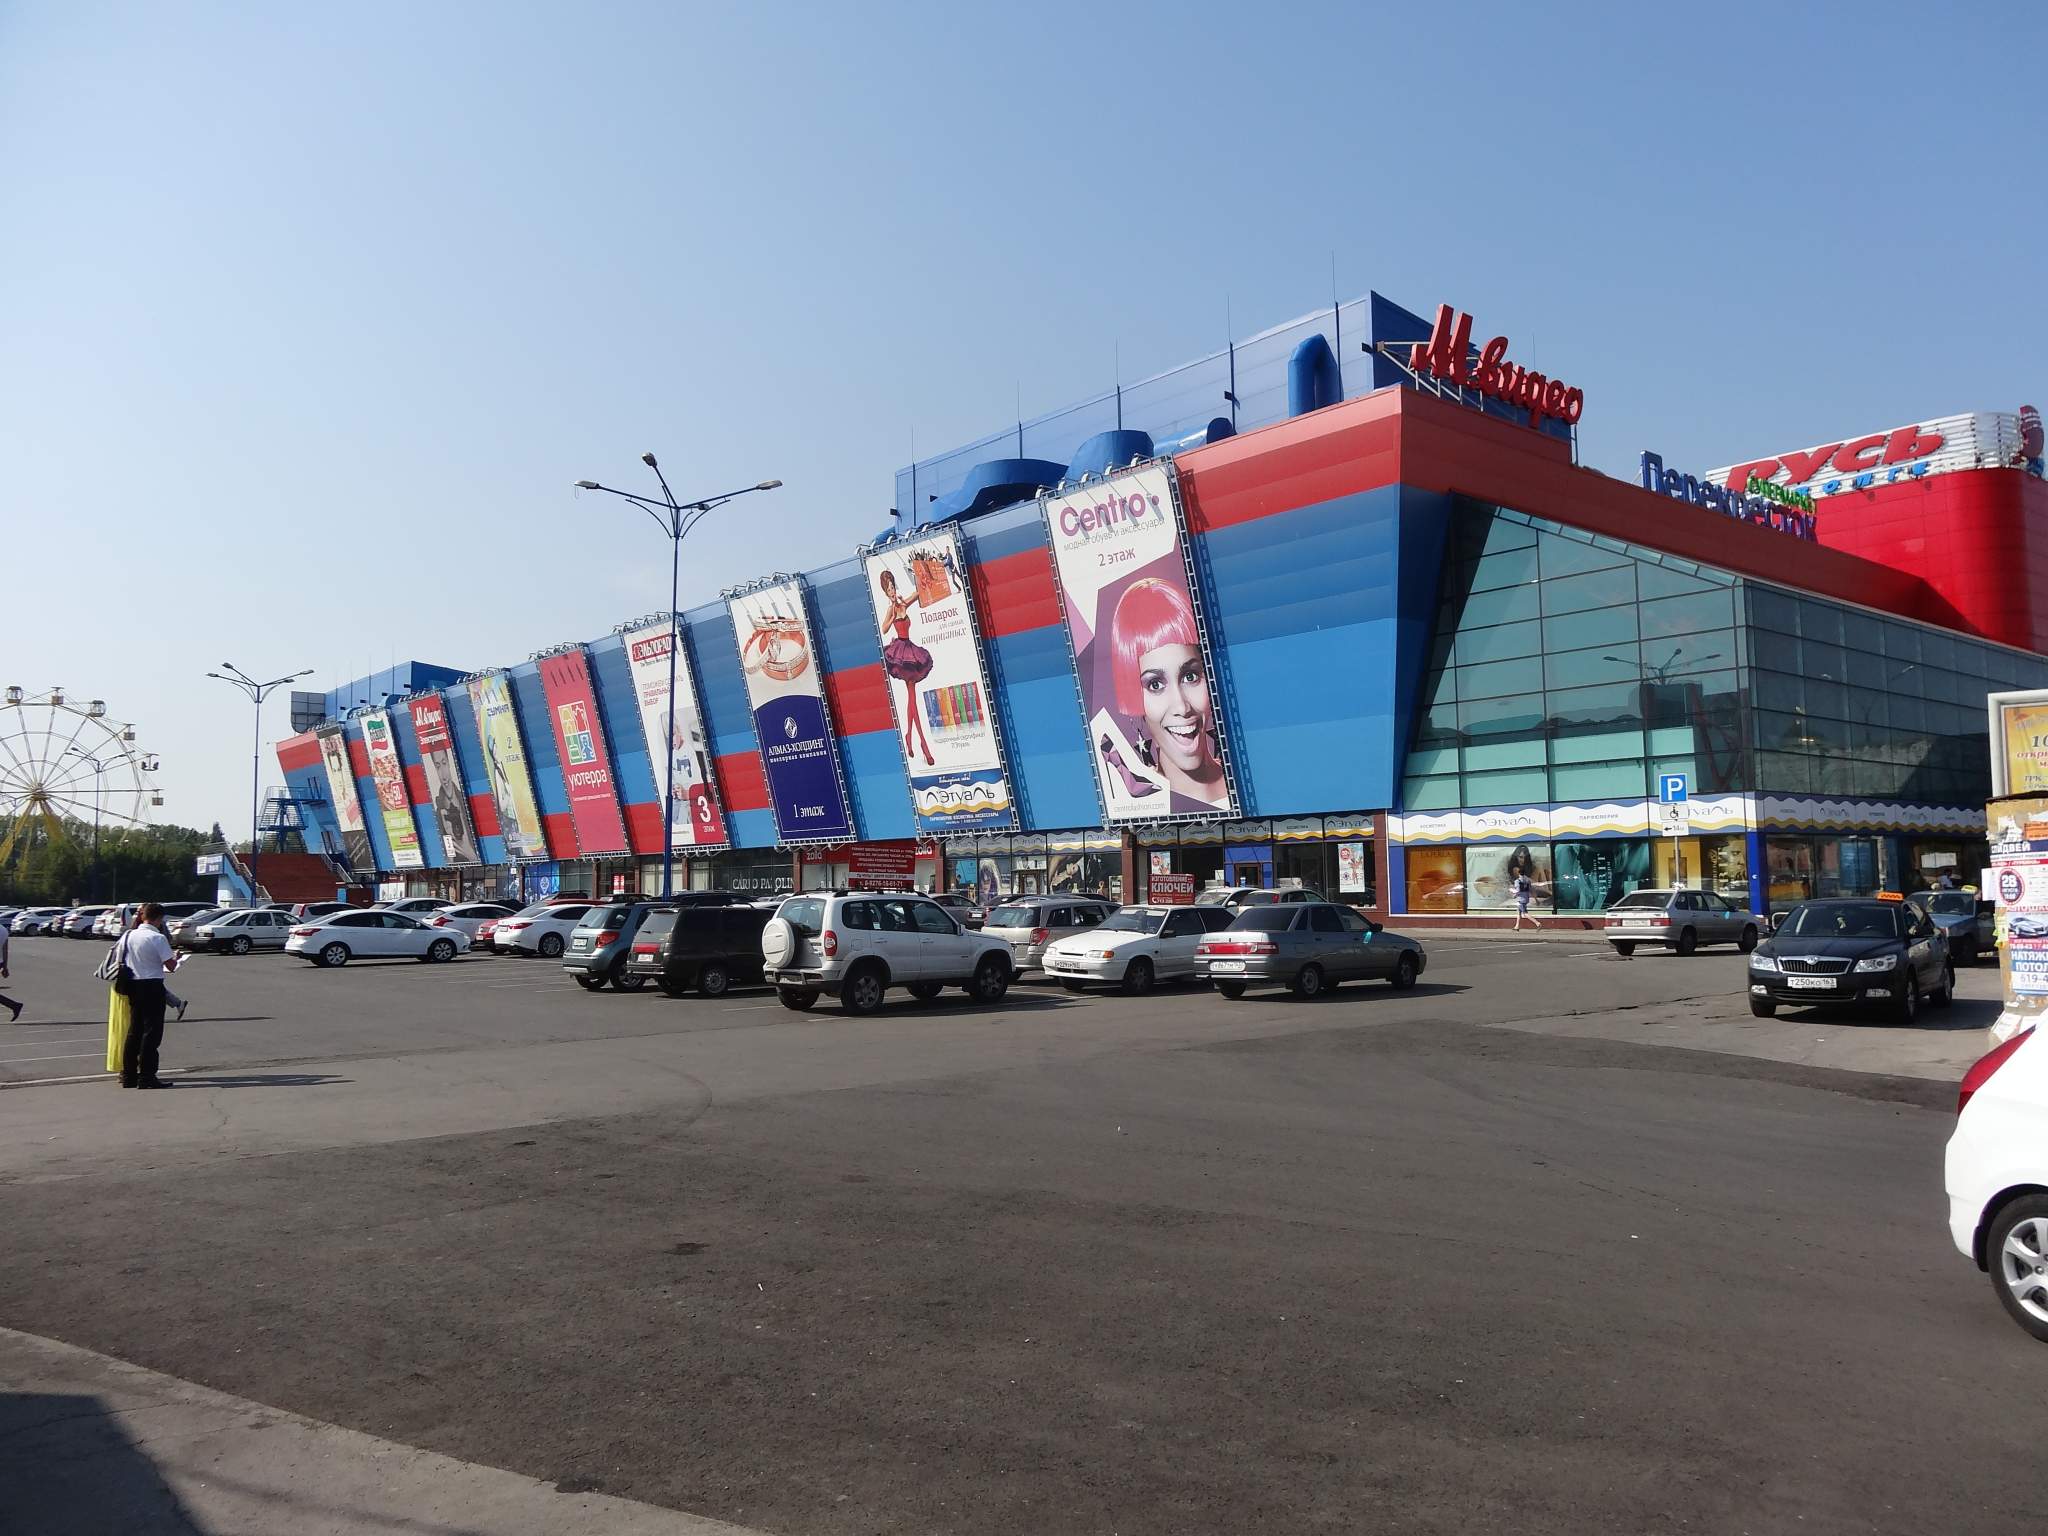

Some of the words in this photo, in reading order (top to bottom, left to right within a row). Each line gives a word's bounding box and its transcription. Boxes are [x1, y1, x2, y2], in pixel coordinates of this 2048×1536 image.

[1060, 493, 1146, 537] Centro
[1098, 553, 1106, 567] 2
[1108, 547, 1136, 565] этаж
[920, 608, 959, 625] Подарок
[921, 628, 967, 645] капризных
[639, 636, 673, 657] ЭЛЬДОРАД
[768, 738, 825, 757] АЛМАЗ-ХОЛДИНГ
[567, 769, 608, 792] уютерра
[697, 795, 712, 823] 3
[793, 803, 799, 818] 1
[800, 805, 825, 818] этаж
[2001, 874, 2017, 888] 28
